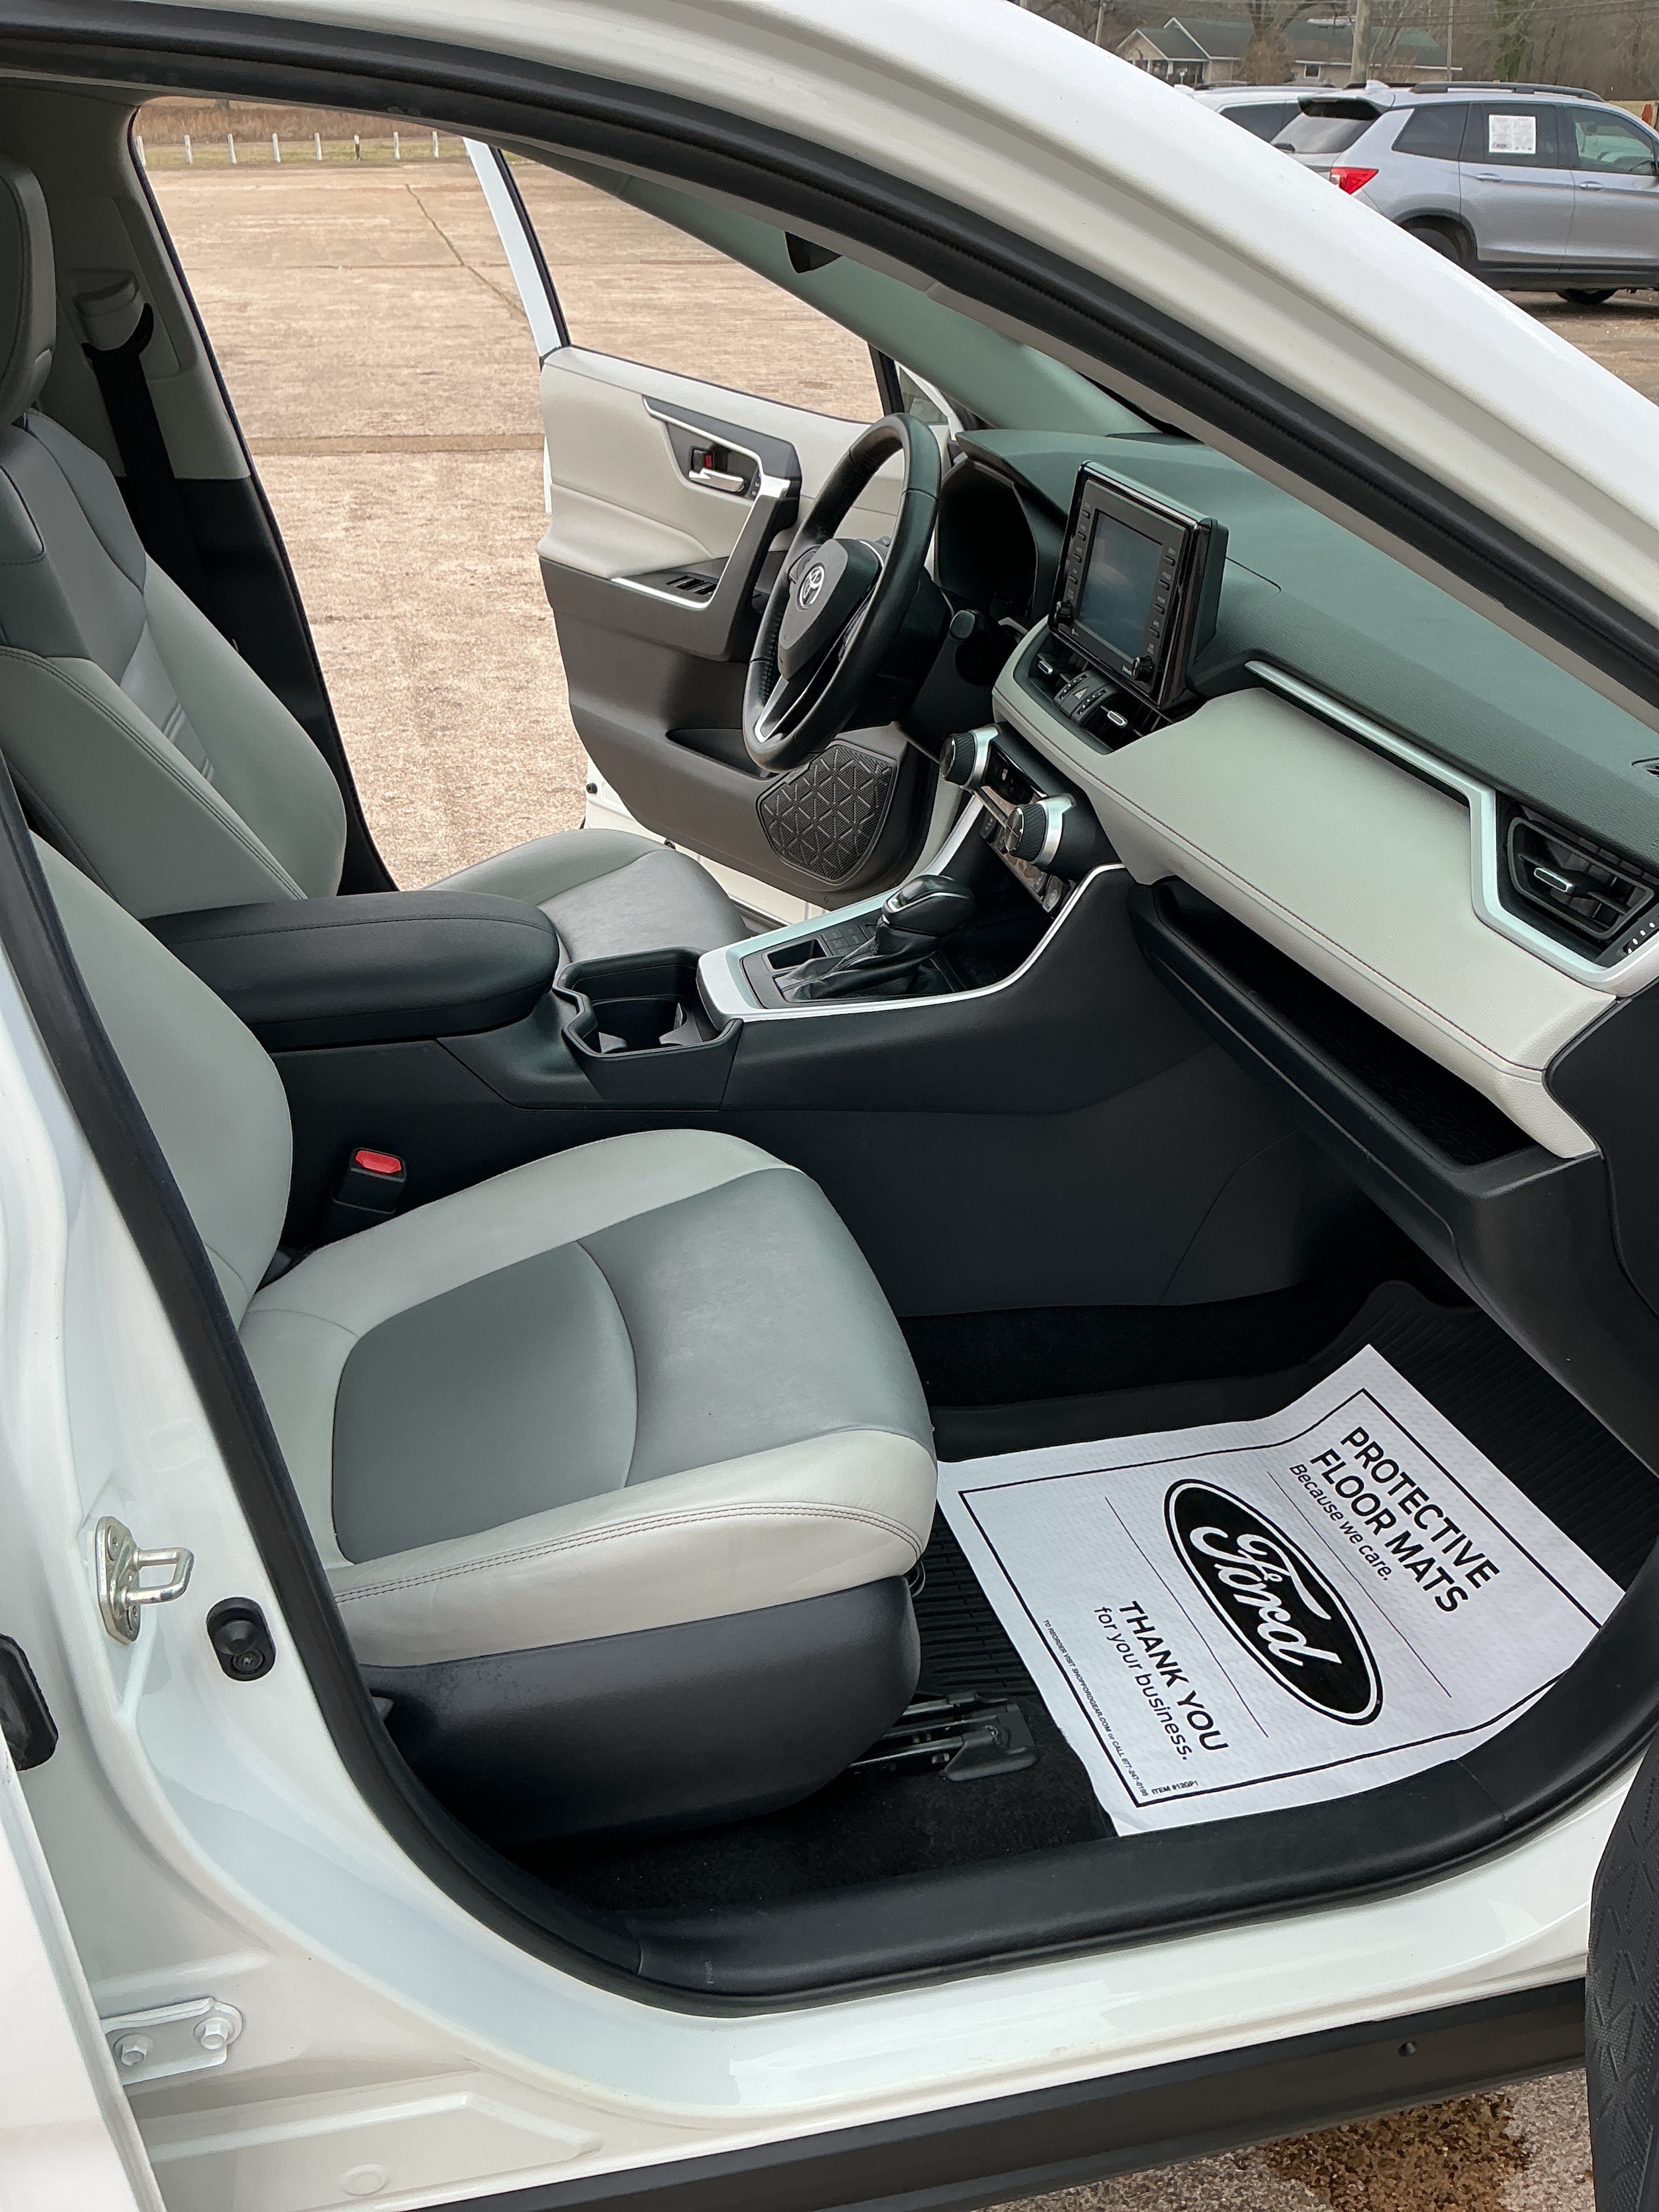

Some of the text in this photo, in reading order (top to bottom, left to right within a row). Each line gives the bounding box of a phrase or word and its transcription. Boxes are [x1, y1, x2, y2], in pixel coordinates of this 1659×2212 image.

[1289, 1464, 1391, 1580] Because we care.
[1310, 1448, 1468, 1611] FLOOR MATS
[1340, 1426, 1500, 1589] PROTECTIVE
[1190, 1526, 1342, 1666] Ford
[1048, 1628, 1067, 1654] REORDER
[1063, 1653, 1076, 1667] VISIT
[1112, 1741, 1124, 1757] CALL
[1094, 1607, 1192, 1760] for your business.
[1119, 1601, 1229, 1750] THANK YOU
[1151, 1785, 1171, 1795] ITEM
